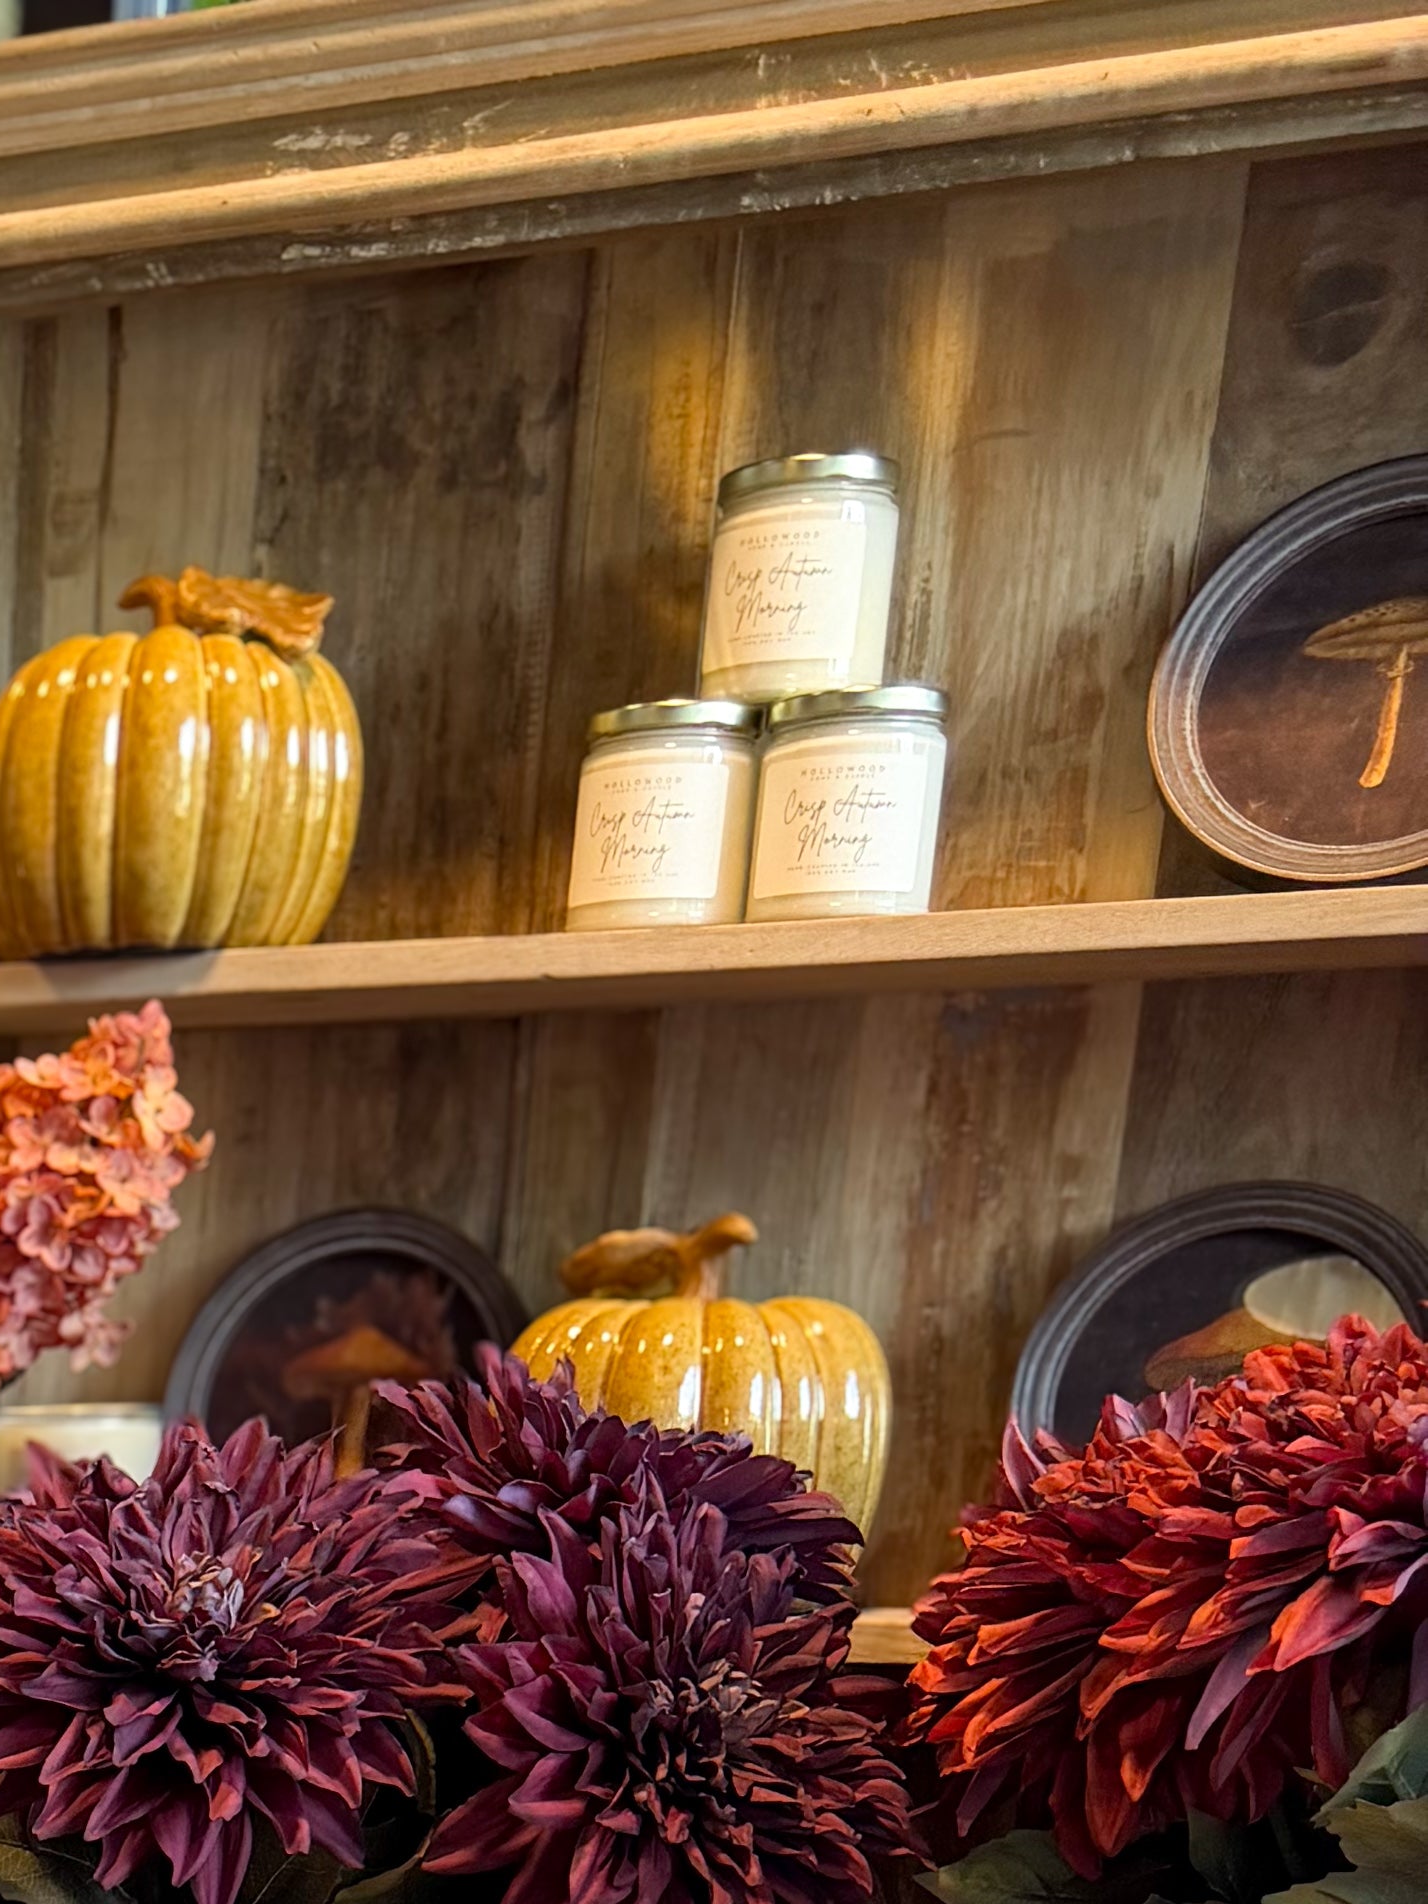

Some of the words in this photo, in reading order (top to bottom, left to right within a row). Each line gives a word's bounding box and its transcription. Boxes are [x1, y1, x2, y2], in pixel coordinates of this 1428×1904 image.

[768, 551, 833, 591] Autumn
[736, 591, 808, 633] Morning
[632, 795, 695, 835] Autumn
[784, 788, 827, 827] Crisp
[833, 784, 897, 824] Autumn
[601, 833, 671, 873] Morning
[798, 821, 873, 863] Morning
